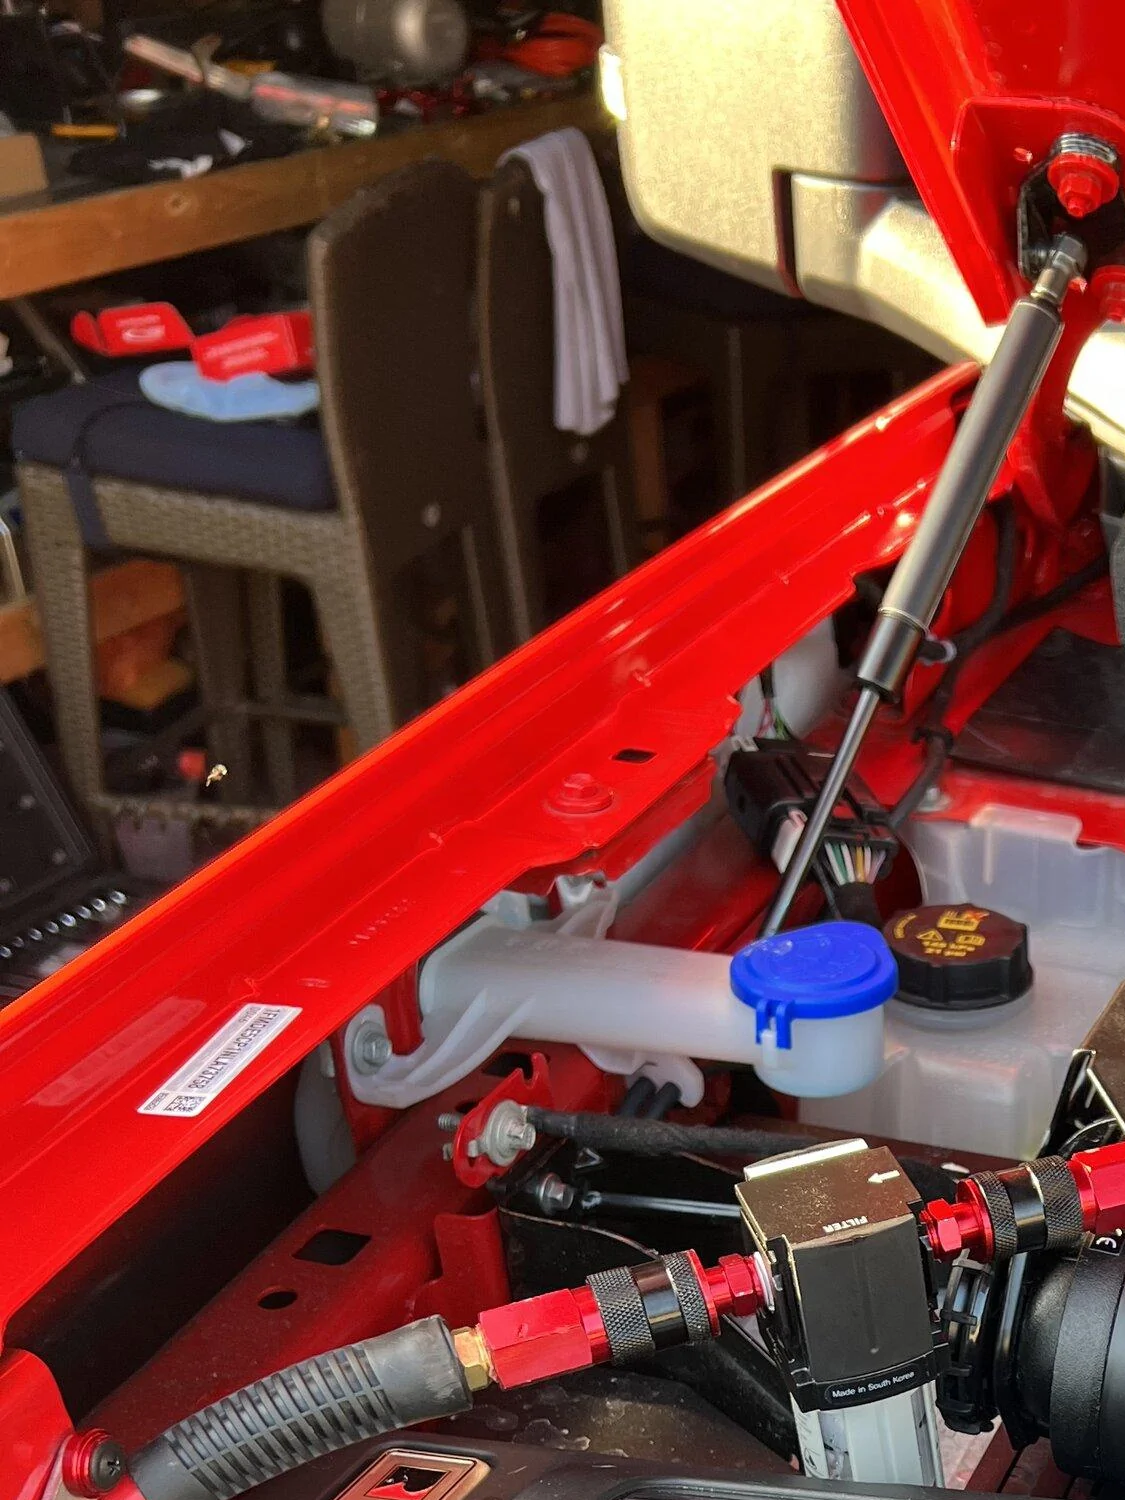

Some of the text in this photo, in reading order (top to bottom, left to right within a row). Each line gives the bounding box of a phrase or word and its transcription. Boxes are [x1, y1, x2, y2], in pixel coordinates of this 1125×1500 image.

[822, 1216, 868, 1233] FILTER
[832, 1371, 915, 1398] Made in South Korea
